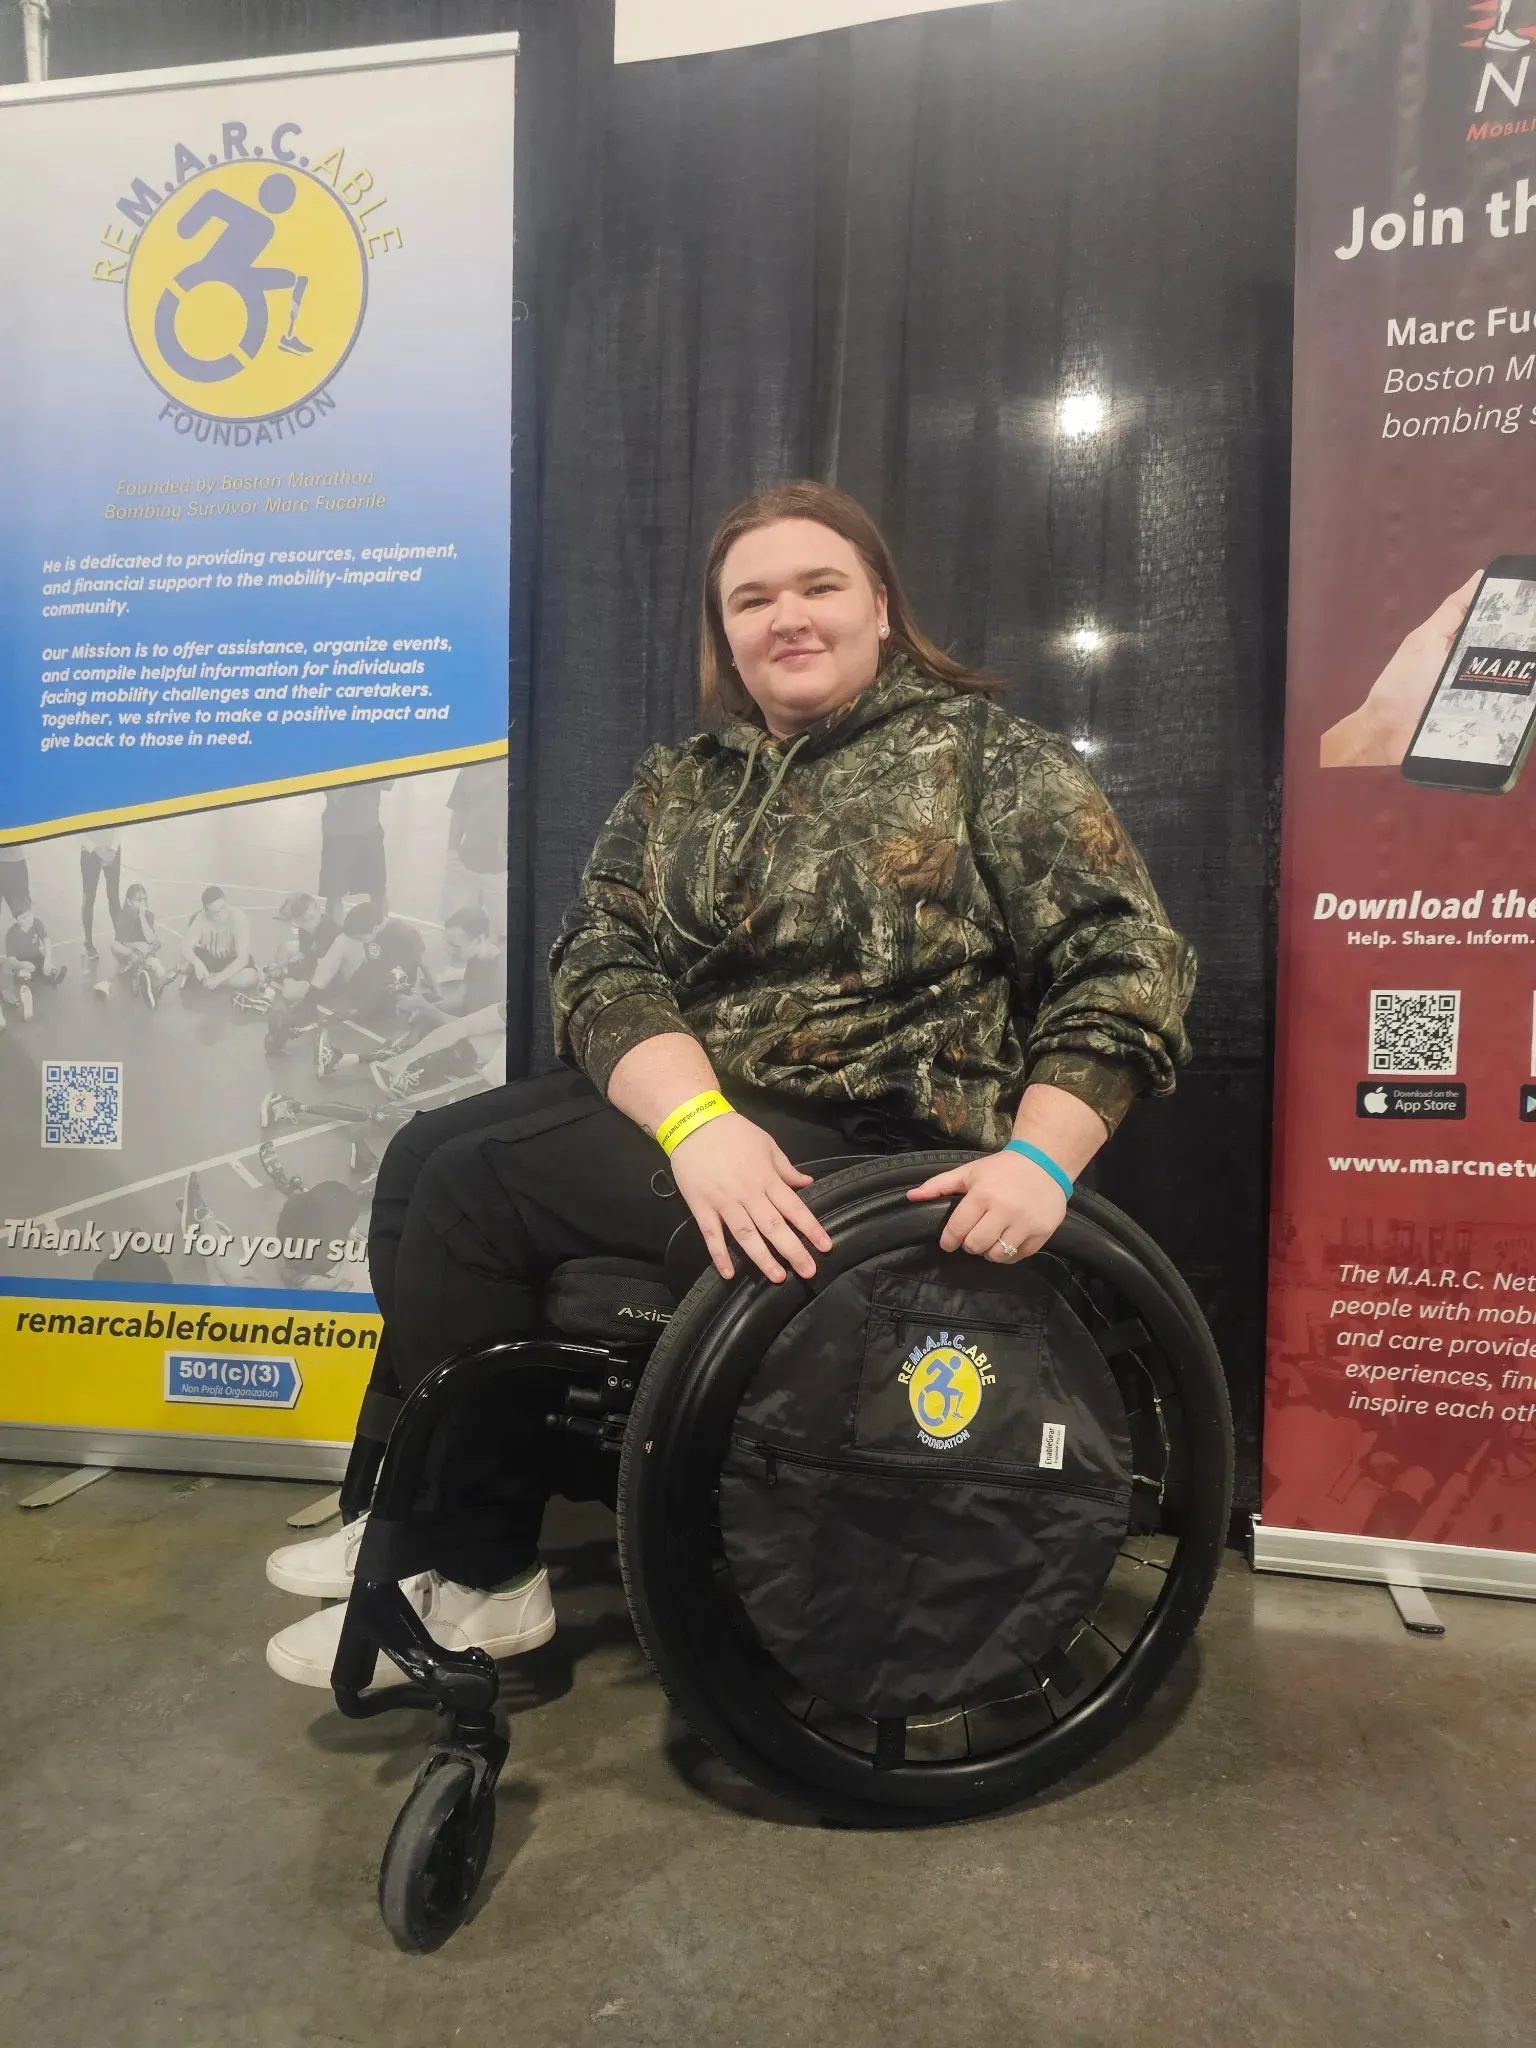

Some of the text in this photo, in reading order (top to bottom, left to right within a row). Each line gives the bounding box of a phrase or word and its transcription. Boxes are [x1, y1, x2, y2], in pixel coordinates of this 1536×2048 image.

[1333, 192, 1464, 261] Join
[1386, 306, 1536, 347] Marc Fu
[1384, 363, 1495, 394] Boston
[157, 390, 336, 447] FOUNDATION
[1381, 404, 1523, 439] bombing
[116, 470, 374, 496] Founded by Boston Marathon
[104, 493, 386, 521] Bombing Survivor Marc Fucarile
[43, 543, 458, 574] He is dedicated to providing resources, equipment,
[43, 566, 422, 596] and financial support to the mobility-impaired
[42, 598, 130, 617] community.
[71, 642, 131, 659] Mission
[135, 642, 148, 658] is
[152, 643, 168, 657] to
[173, 641, 213, 659] offer
[217, 639, 307, 656] assistance,
[313, 636, 388, 656] organize
[393, 636, 452, 652] events,
[41, 658, 425, 683] and compile helpful information for individuals
[40, 682, 433, 707] facing mobility challenges and their caretakers.
[41, 705, 450, 729] Together, we strive to make a positive impact and
[40, 730, 253, 752] give back to those in need.
[1313, 889, 1485, 920] Download
[1347, 929, 1536, 948] Help. Share. Inform.
[1393, 1089, 1433, 1098] Download
[1446, 1090, 1459, 1098] the
[1394, 1099, 1457, 1113] App Store
[4, 1218, 104, 1251] Thank
[109, 1230, 174, 1260] you
[183, 1224, 234, 1256] for
[239, 1235, 322, 1267] your
[1339, 1264, 1536, 1292] The M.A.R.C. Net
[1329, 1298, 1412, 1320] people
[1419, 1301, 1471, 1322] with
[16, 1310, 378, 1350] remarcablefoundation
[1336, 1329, 1384, 1348] and
[1388, 1332, 1443, 1351] care
[179, 1360, 280, 1387] 501(c)(3)
[1345, 1362, 1536, 1391] experiences, fin
[182, 1384, 278, 1399] Non Profit Organization
[1348, 1391, 1429, 1416] inspire
[1435, 1399, 1494, 1420] each
[917, 1429, 970, 1450] FOUNDATION
